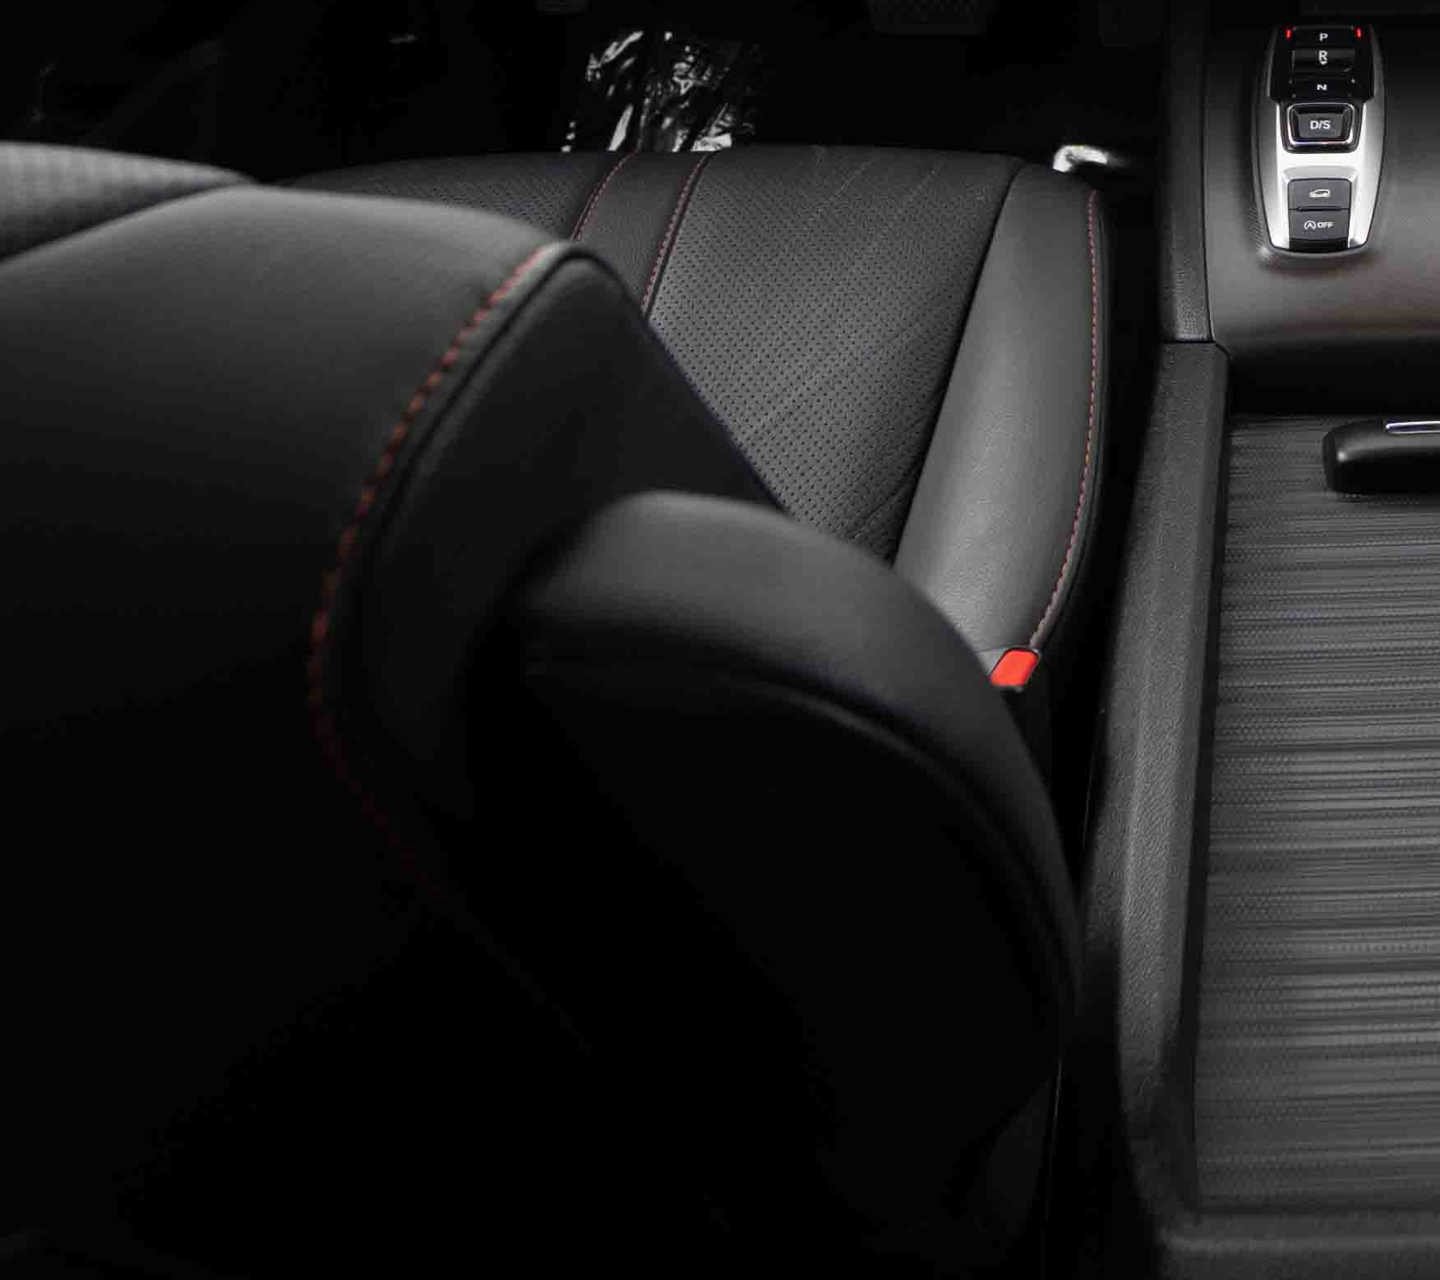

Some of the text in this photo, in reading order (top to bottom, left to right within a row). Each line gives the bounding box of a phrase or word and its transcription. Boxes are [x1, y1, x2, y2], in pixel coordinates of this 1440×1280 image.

[1319, 33, 1329, 42] P
[1318, 49, 1328, 60] R
[1316, 83, 1328, 92] N
[1309, 119, 1332, 131] D/S
[1316, 221, 1334, 229] OFF
